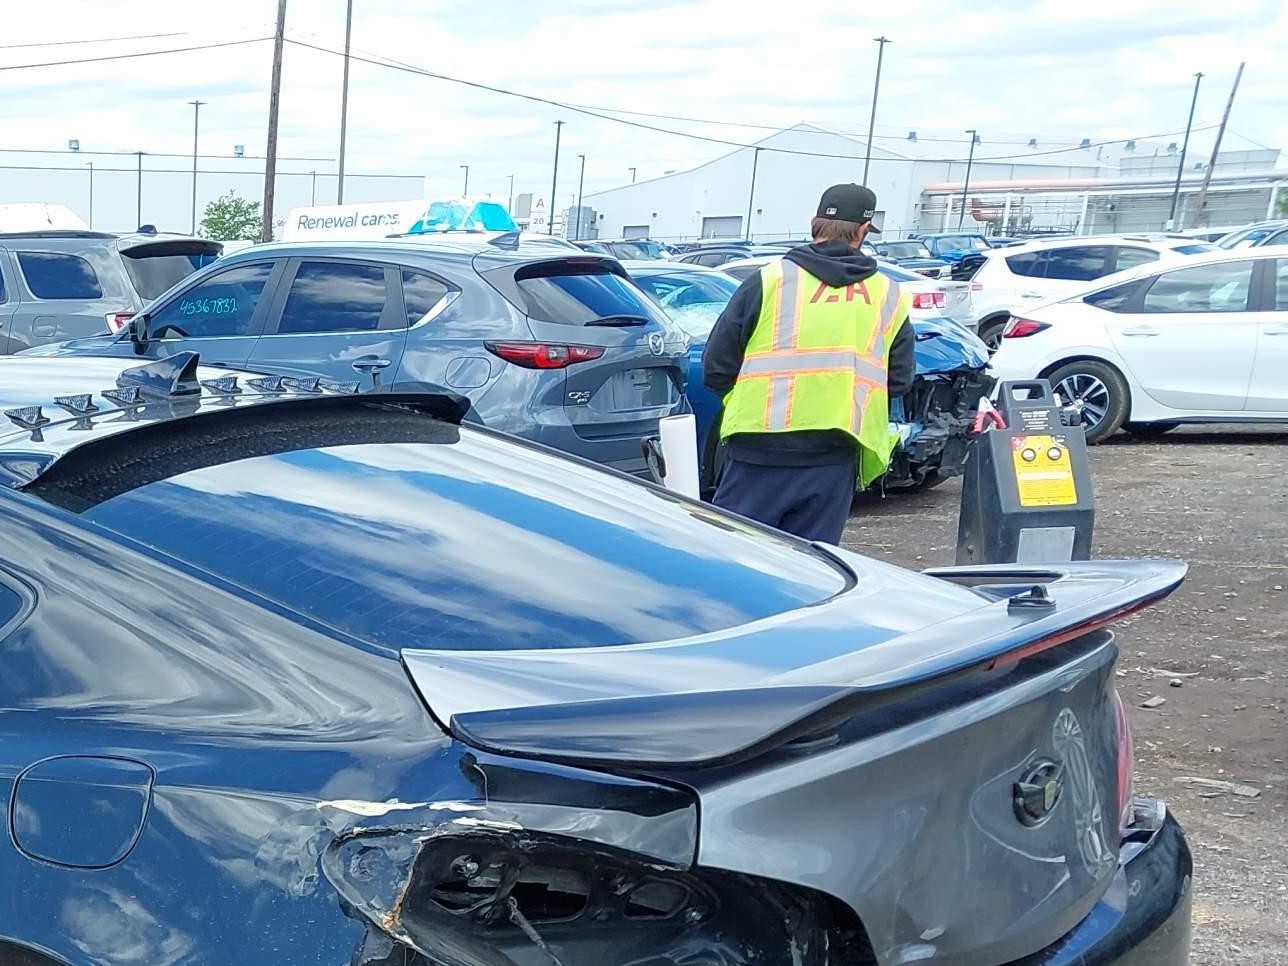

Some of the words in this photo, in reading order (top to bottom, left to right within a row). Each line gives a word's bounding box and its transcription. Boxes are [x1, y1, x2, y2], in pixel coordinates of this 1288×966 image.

[535, 198, 545, 208] A
[297, 211, 358, 230] Renewal
[532, 217, 545, 225] 20
[180, 298, 238, 315] 45367832
